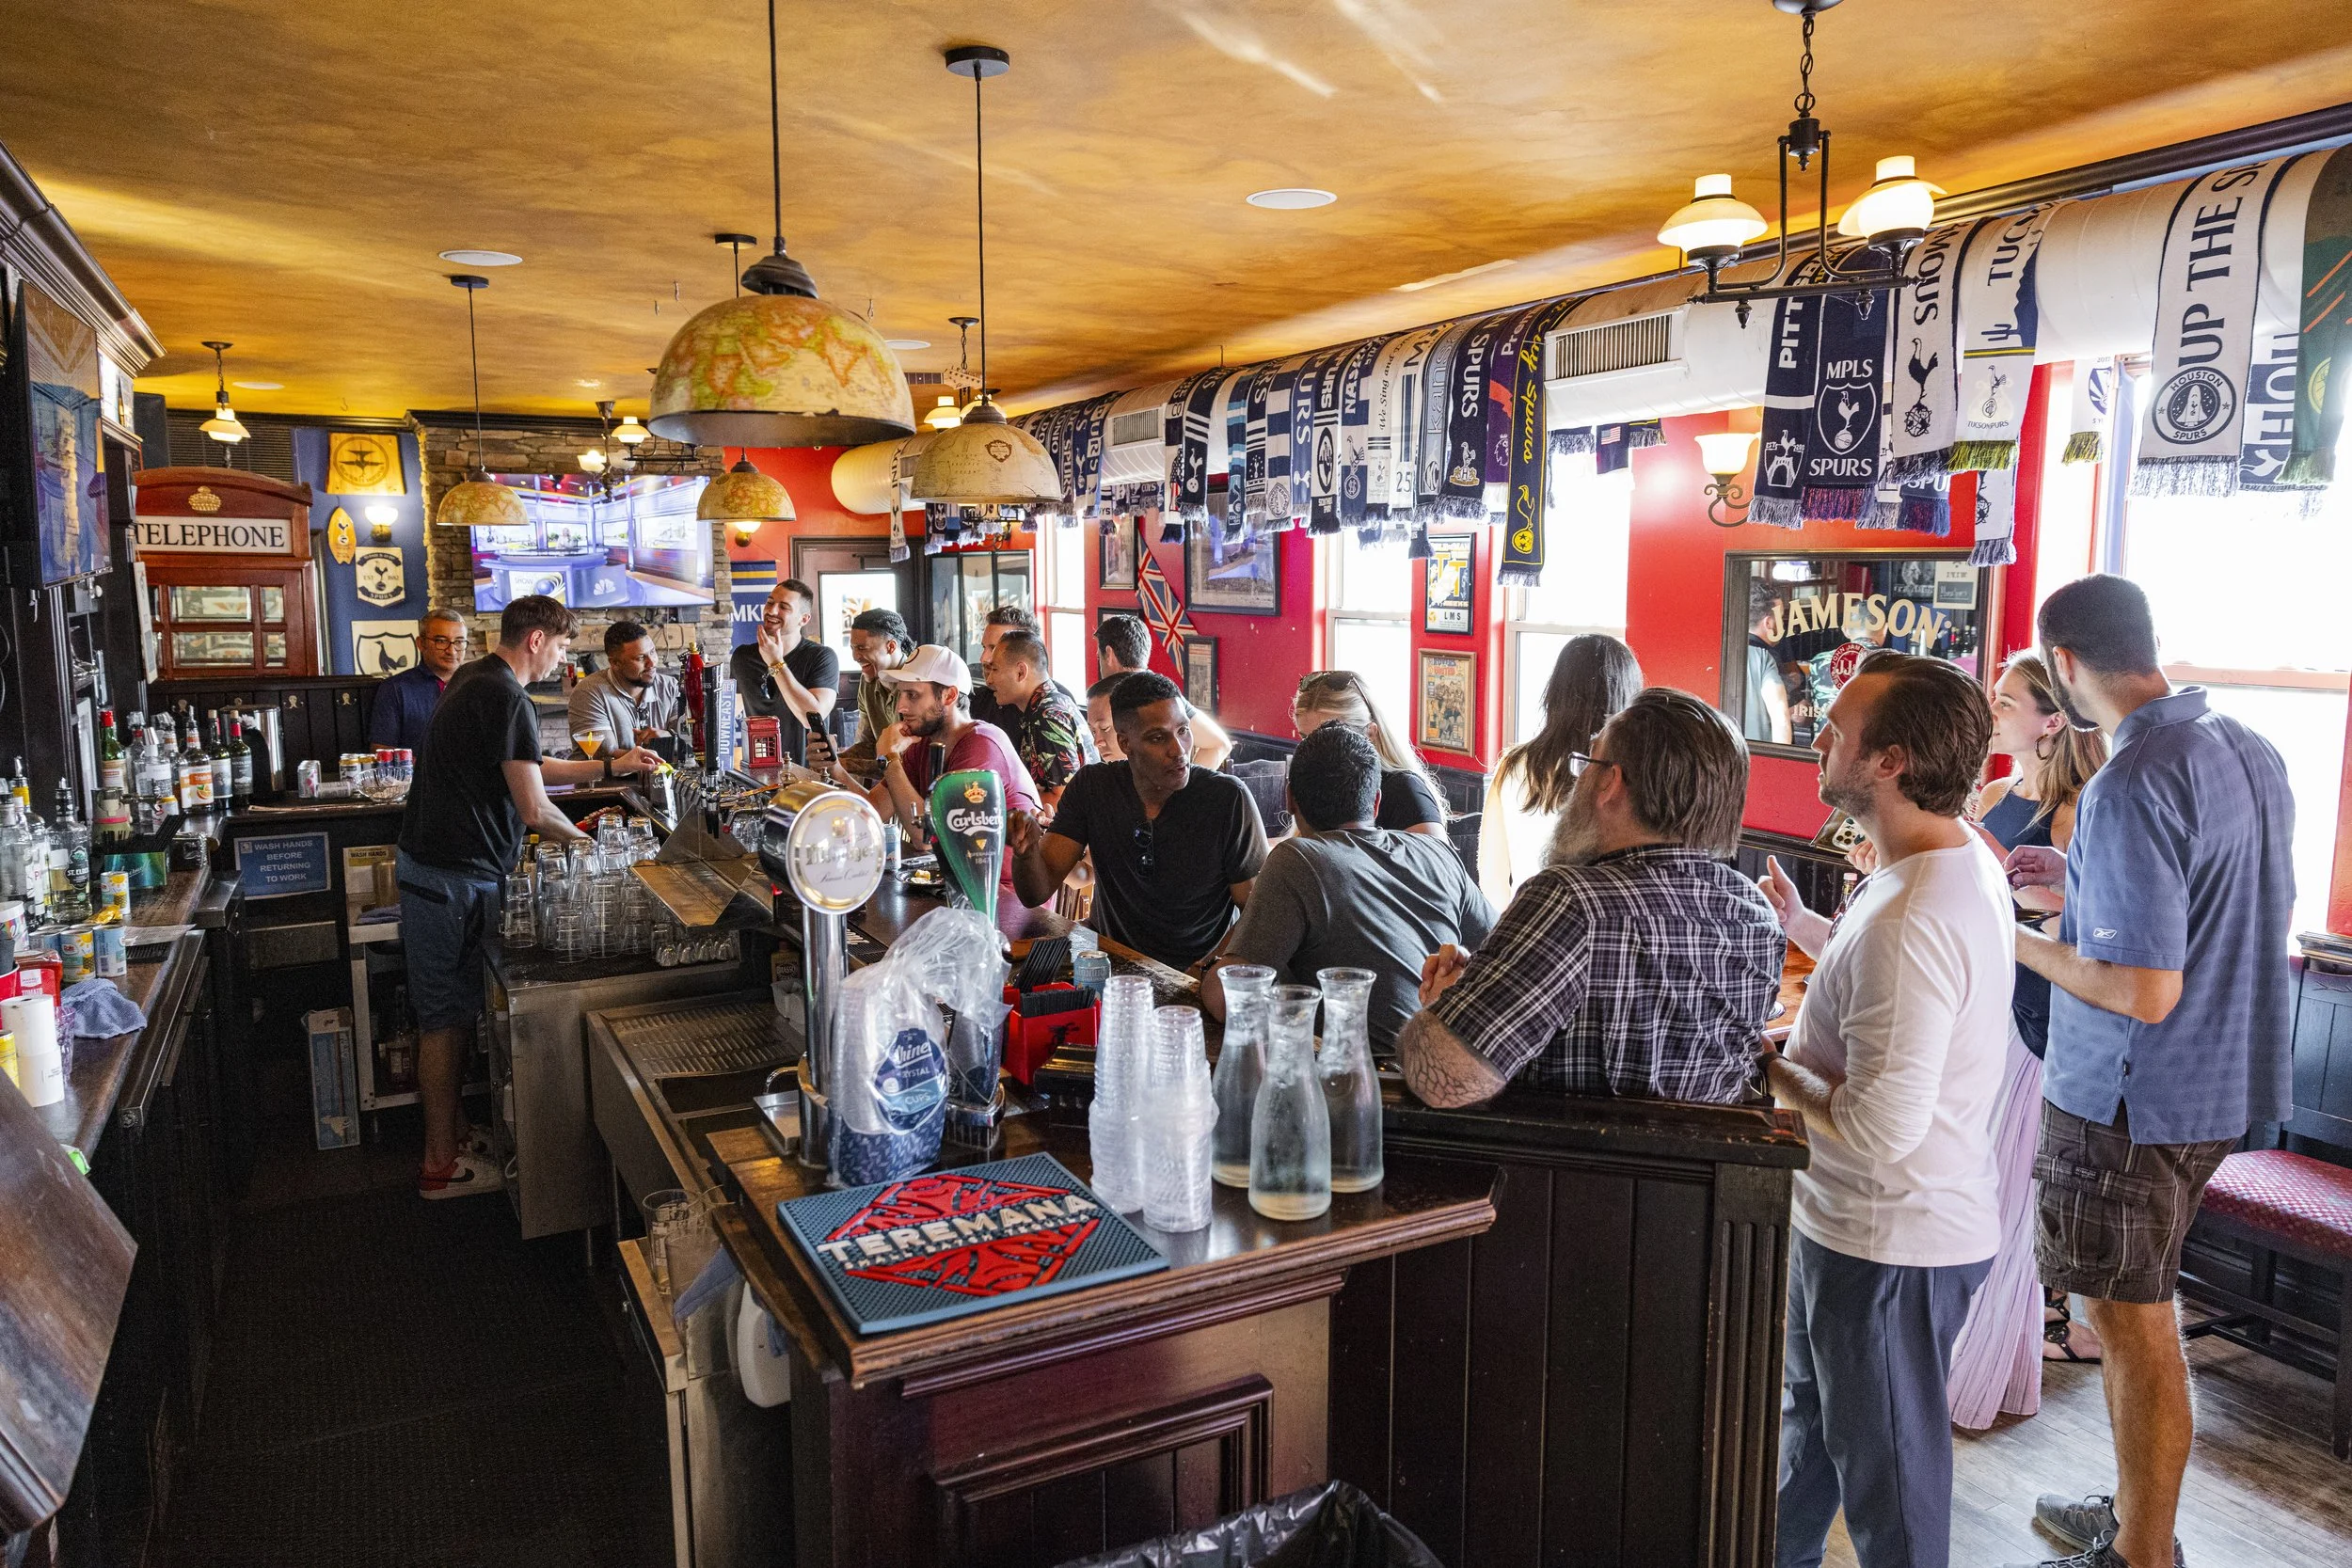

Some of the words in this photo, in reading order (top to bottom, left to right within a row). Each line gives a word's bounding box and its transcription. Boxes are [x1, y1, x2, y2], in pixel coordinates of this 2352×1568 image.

[2186, 197, 2243, 292] THE
[2178, 303, 2225, 368] UP
[1461, 333, 1489, 418] SPURS
[1826, 359, 1873, 379] MPLS
[1380, 380, 1389, 406] Sing
[1386, 355, 1394, 376] and
[2170, 371, 2223, 391] HOUSTON
[1520, 380, 1537, 464] Spurs
[2173, 429, 2207, 440] SPURS
[1063, 440, 1073, 496] SPURS
[1809, 458, 1872, 477] SPURS
[1396, 471, 1411, 492] 25
[135, 523, 284, 547] TELEPHONE
[515, 577, 533, 585] SHOW
[1766, 593, 1946, 649] JAMESON
[1833, 647, 1845, 666] JOHN
[721, 694, 732, 755] DOWNEAST
[946, 807, 1004, 836] Carlsberg
[254, 842, 280, 850] WASH
[282, 840, 313, 848] HANDS
[266, 851, 303, 861] BEFORE
[260, 863, 310, 872] RETURNING
[279, 873, 307, 881] WORK
[905, 1093, 930, 1105] CUPS
[817, 1195, 1098, 1262] TEREMANA
[844, 1252, 914, 1270] SMALL
[925, 1233, 993, 1253] BATCH
[1004, 1213, 1089, 1235] TEQUILA
